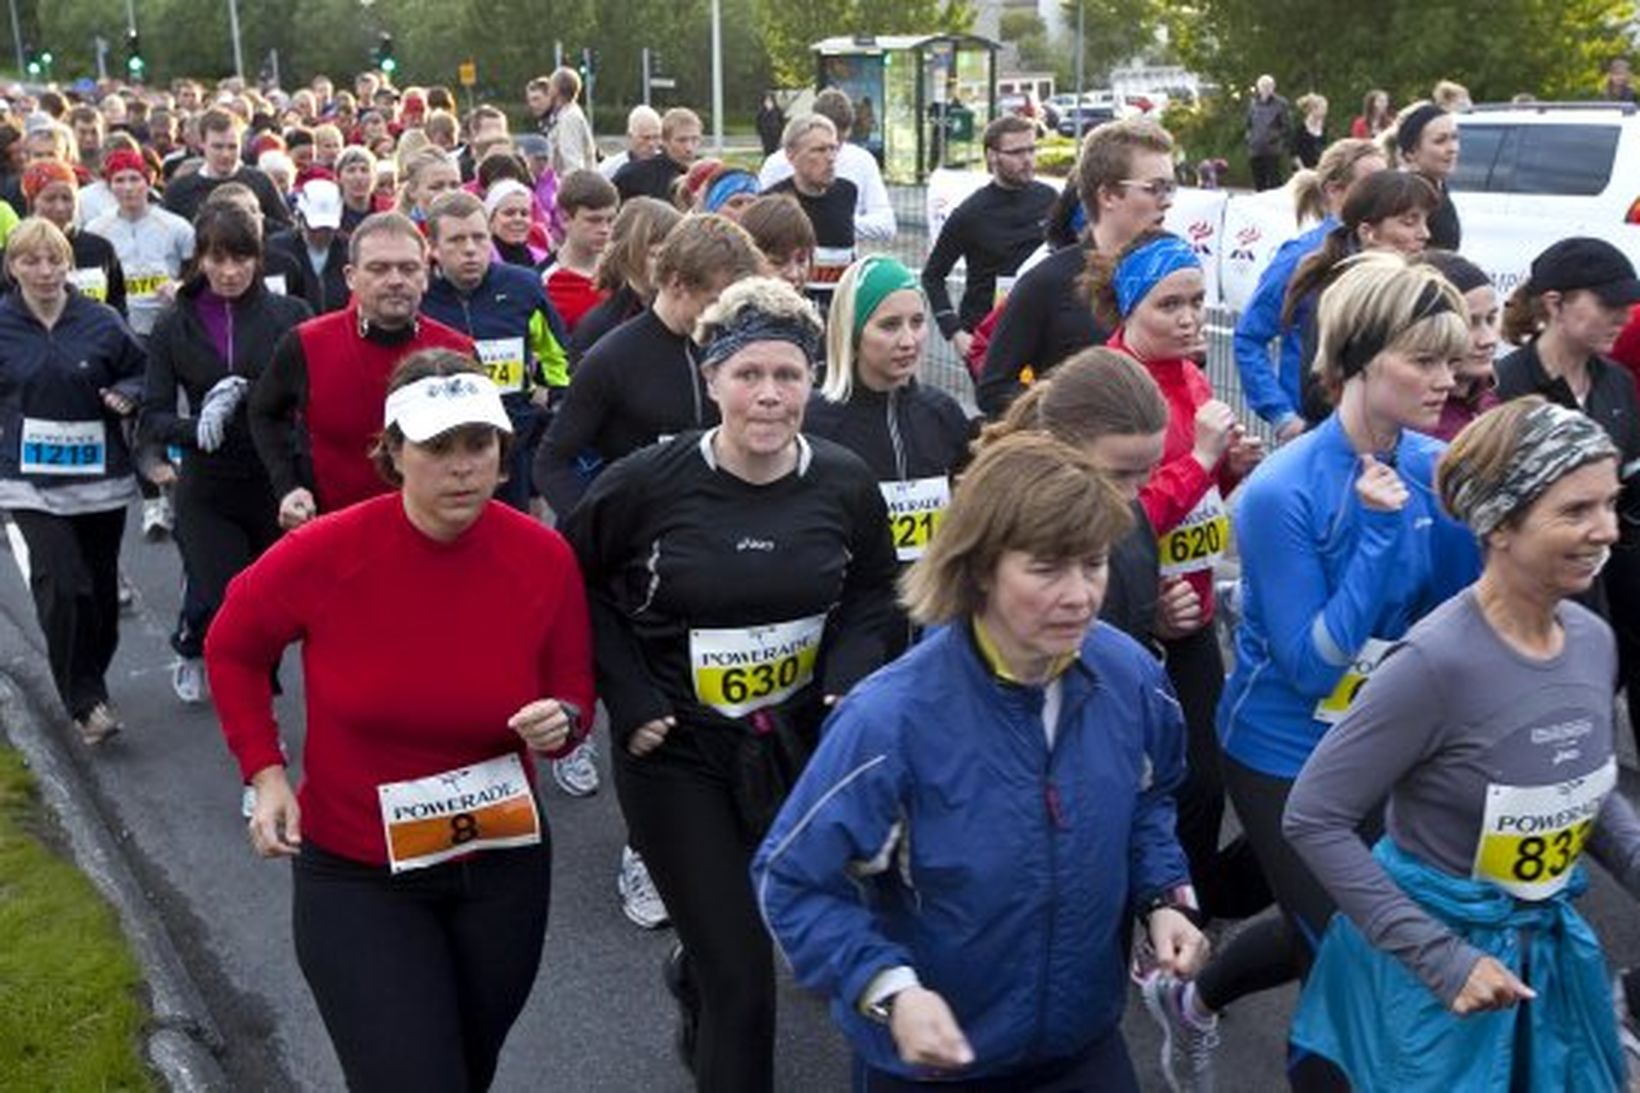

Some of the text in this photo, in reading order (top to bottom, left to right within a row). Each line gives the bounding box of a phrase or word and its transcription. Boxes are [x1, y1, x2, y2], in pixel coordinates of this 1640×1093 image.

[34, 443, 98, 465] 1219
[1171, 521, 1220, 563] 620
[702, 635, 814, 666] POWERADE
[721, 656, 799, 704] 630
[393, 781, 517, 820] POWERADE
[450, 813, 479, 845] 8
